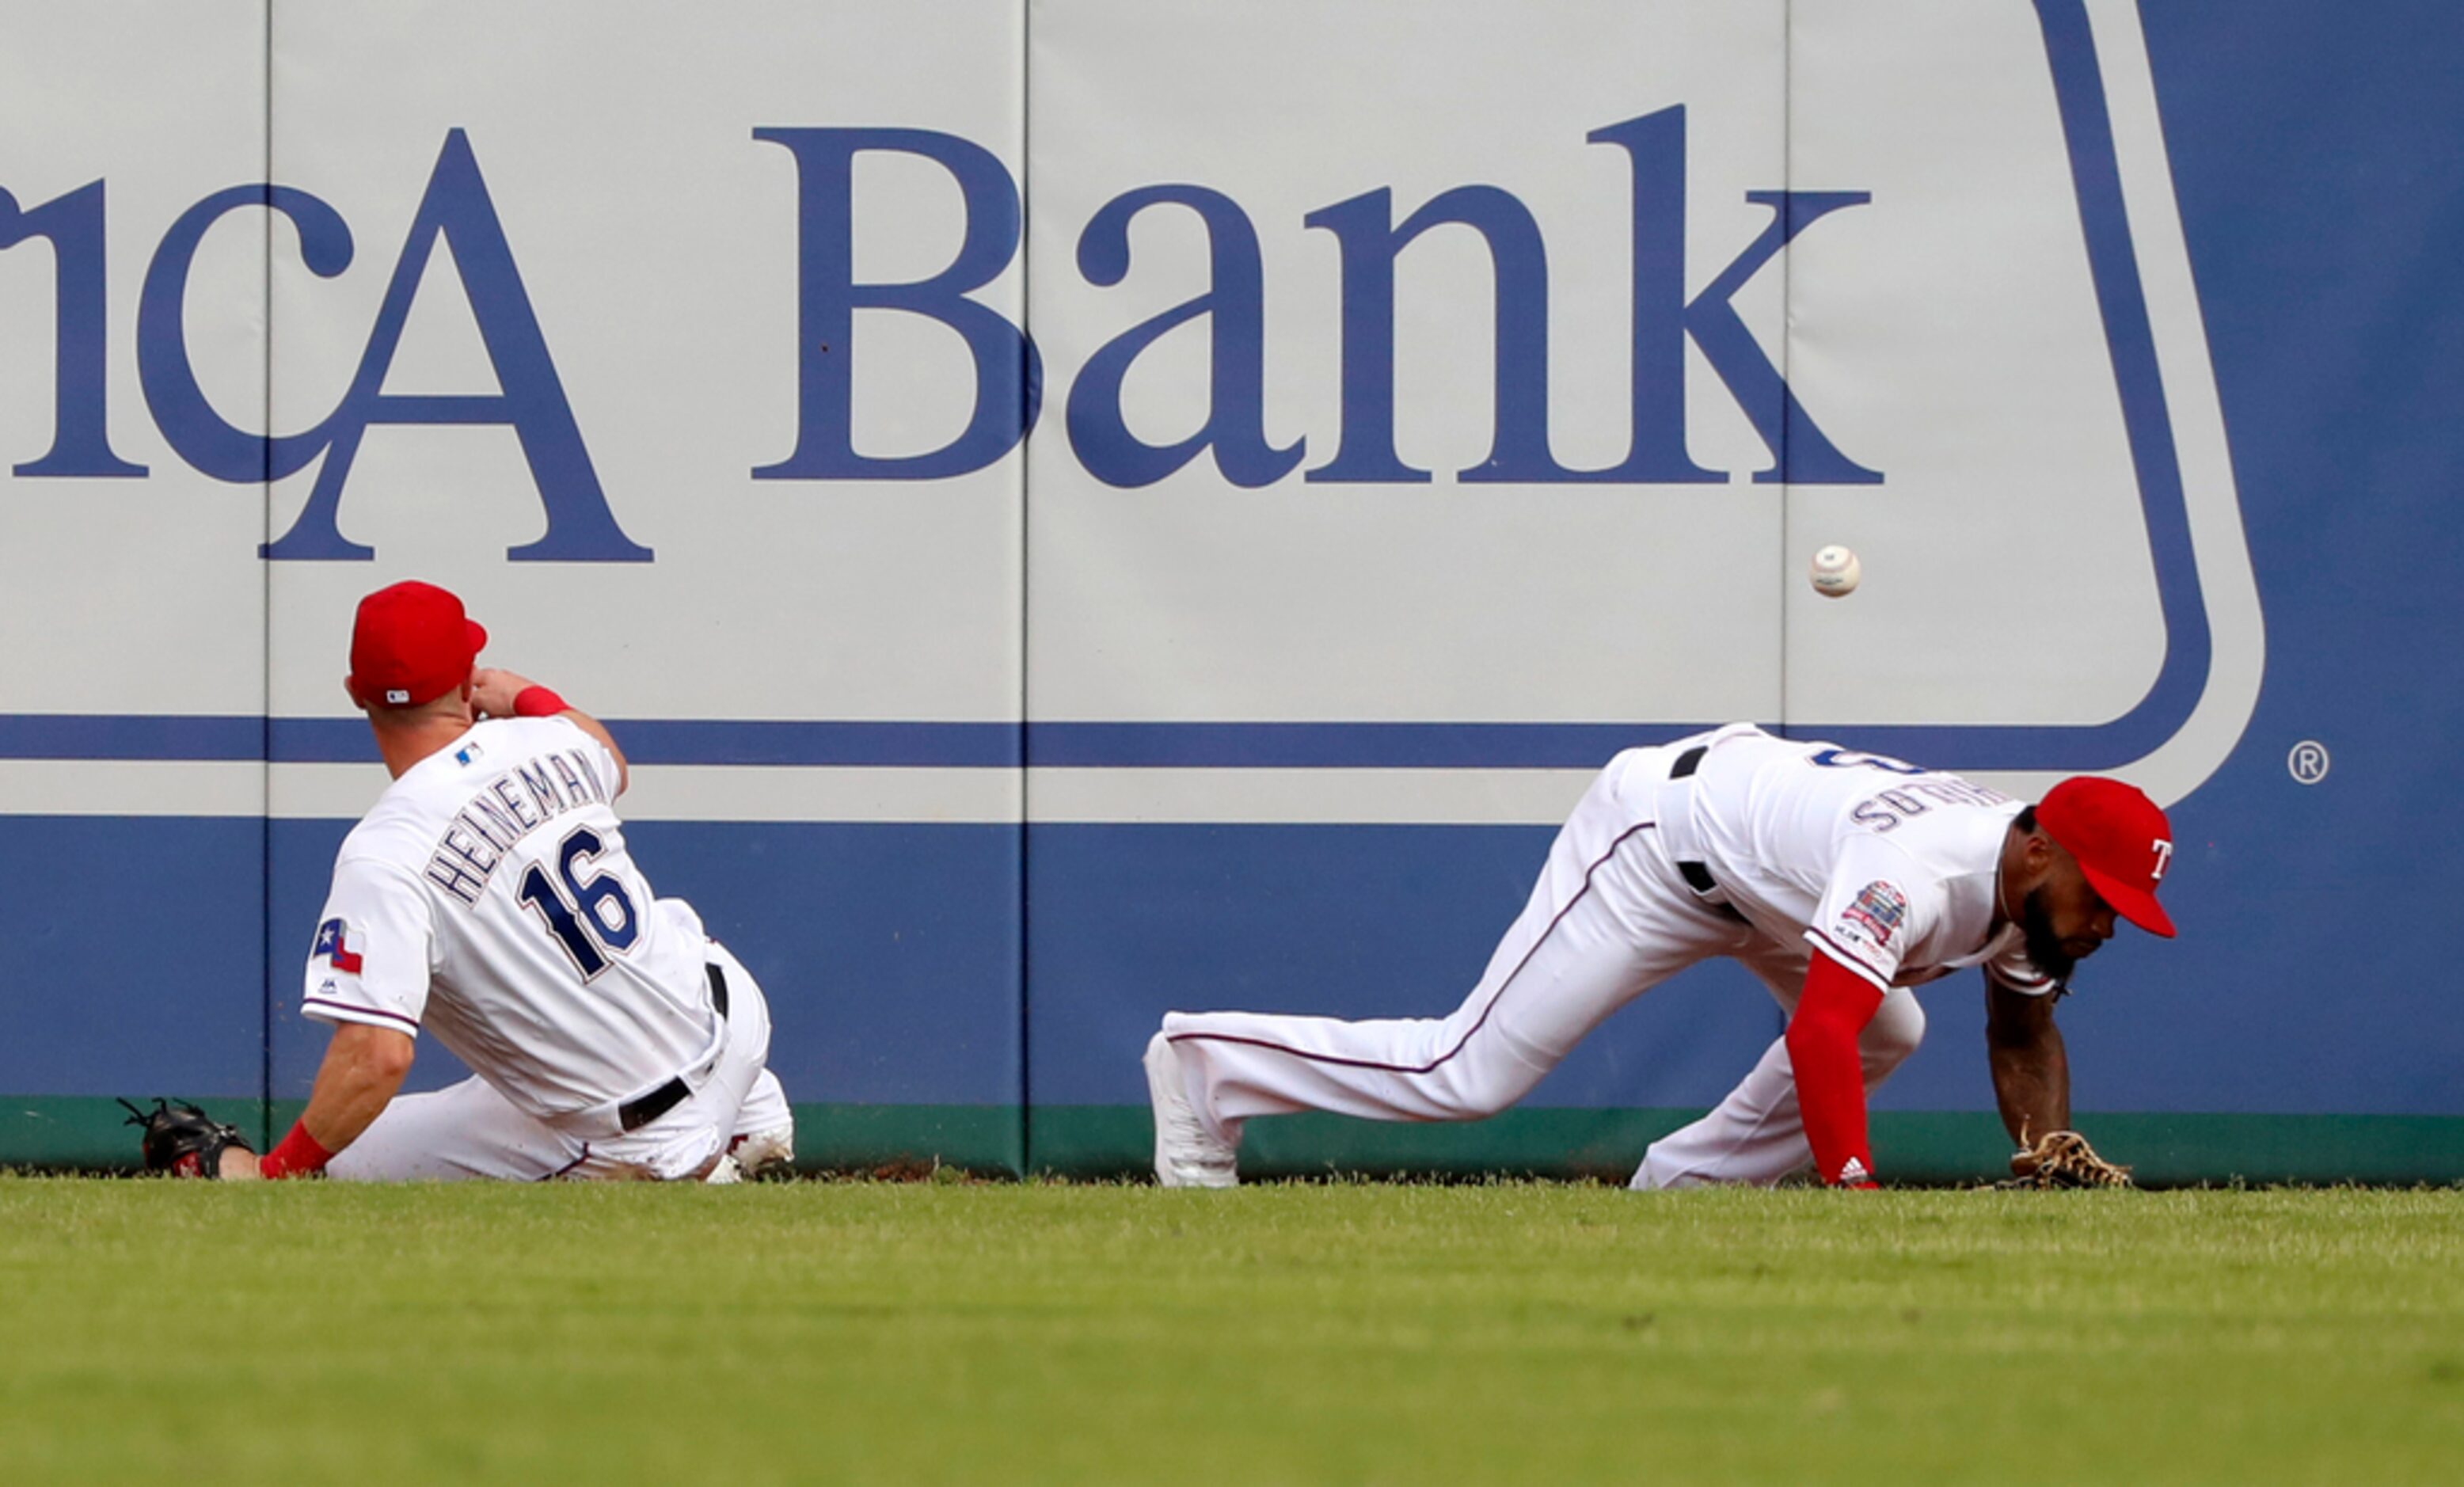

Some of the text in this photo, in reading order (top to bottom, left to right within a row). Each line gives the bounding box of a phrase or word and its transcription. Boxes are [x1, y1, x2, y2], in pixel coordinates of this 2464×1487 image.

[754, 104, 1883, 486] Bank
[424, 748, 608, 910] HEINEMAN
[515, 823, 644, 984] 16
[2150, 838, 2173, 880] T
